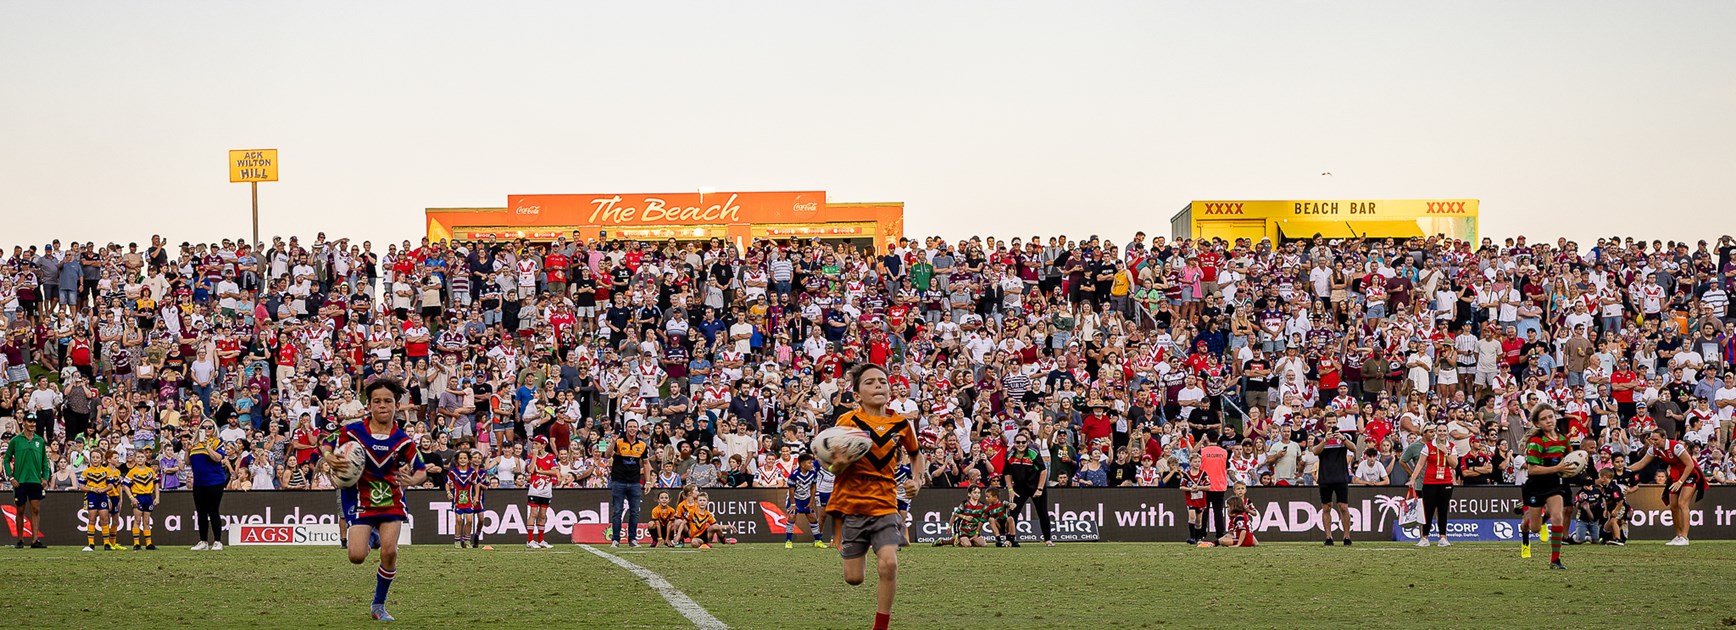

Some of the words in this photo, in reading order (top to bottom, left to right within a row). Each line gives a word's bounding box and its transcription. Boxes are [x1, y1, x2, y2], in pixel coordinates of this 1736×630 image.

[236, 159, 271, 167] WILTON
[240, 168, 268, 179] HILL
[588, 195, 635, 223] The
[641, 193, 740, 222] Beach
[1204, 203, 1244, 215] XXXX
[1294, 202, 1338, 215] BEACH
[1350, 202, 1376, 214] BAR
[1426, 202, 1466, 213] XXXX
[707, 501, 757, 516] QUENT
[1449, 499, 1519, 515] REQUENT
[165, 514, 181, 531] a
[192, 507, 271, 531] tavel
[1114, 503, 1175, 527] with
[1630, 509, 1674, 527] ore
[1689, 509, 1704, 526] a
[245, 528, 289, 542] AGS
